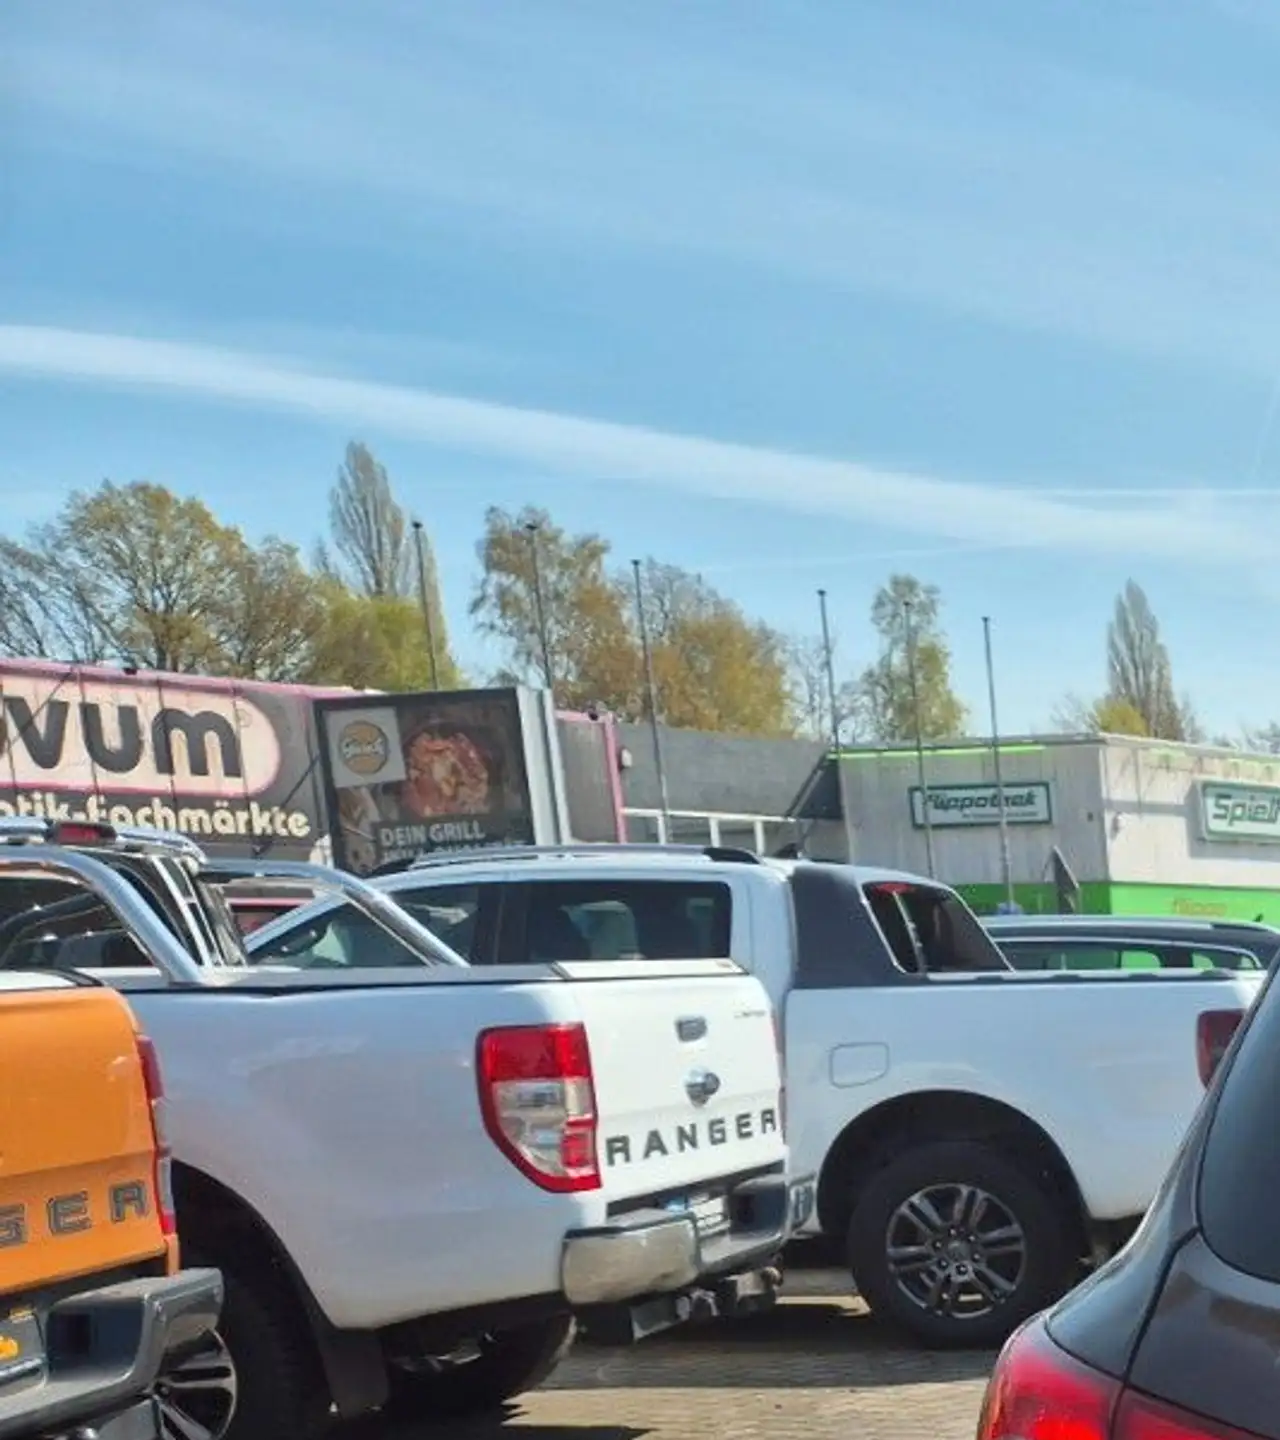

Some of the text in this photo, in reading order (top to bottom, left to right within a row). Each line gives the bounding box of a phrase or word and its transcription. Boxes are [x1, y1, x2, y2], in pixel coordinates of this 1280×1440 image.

[0, 695, 242, 778] vum
[380, 819, 486, 847] DEIN GRILL
[605, 1107, 778, 1167] RANGER
